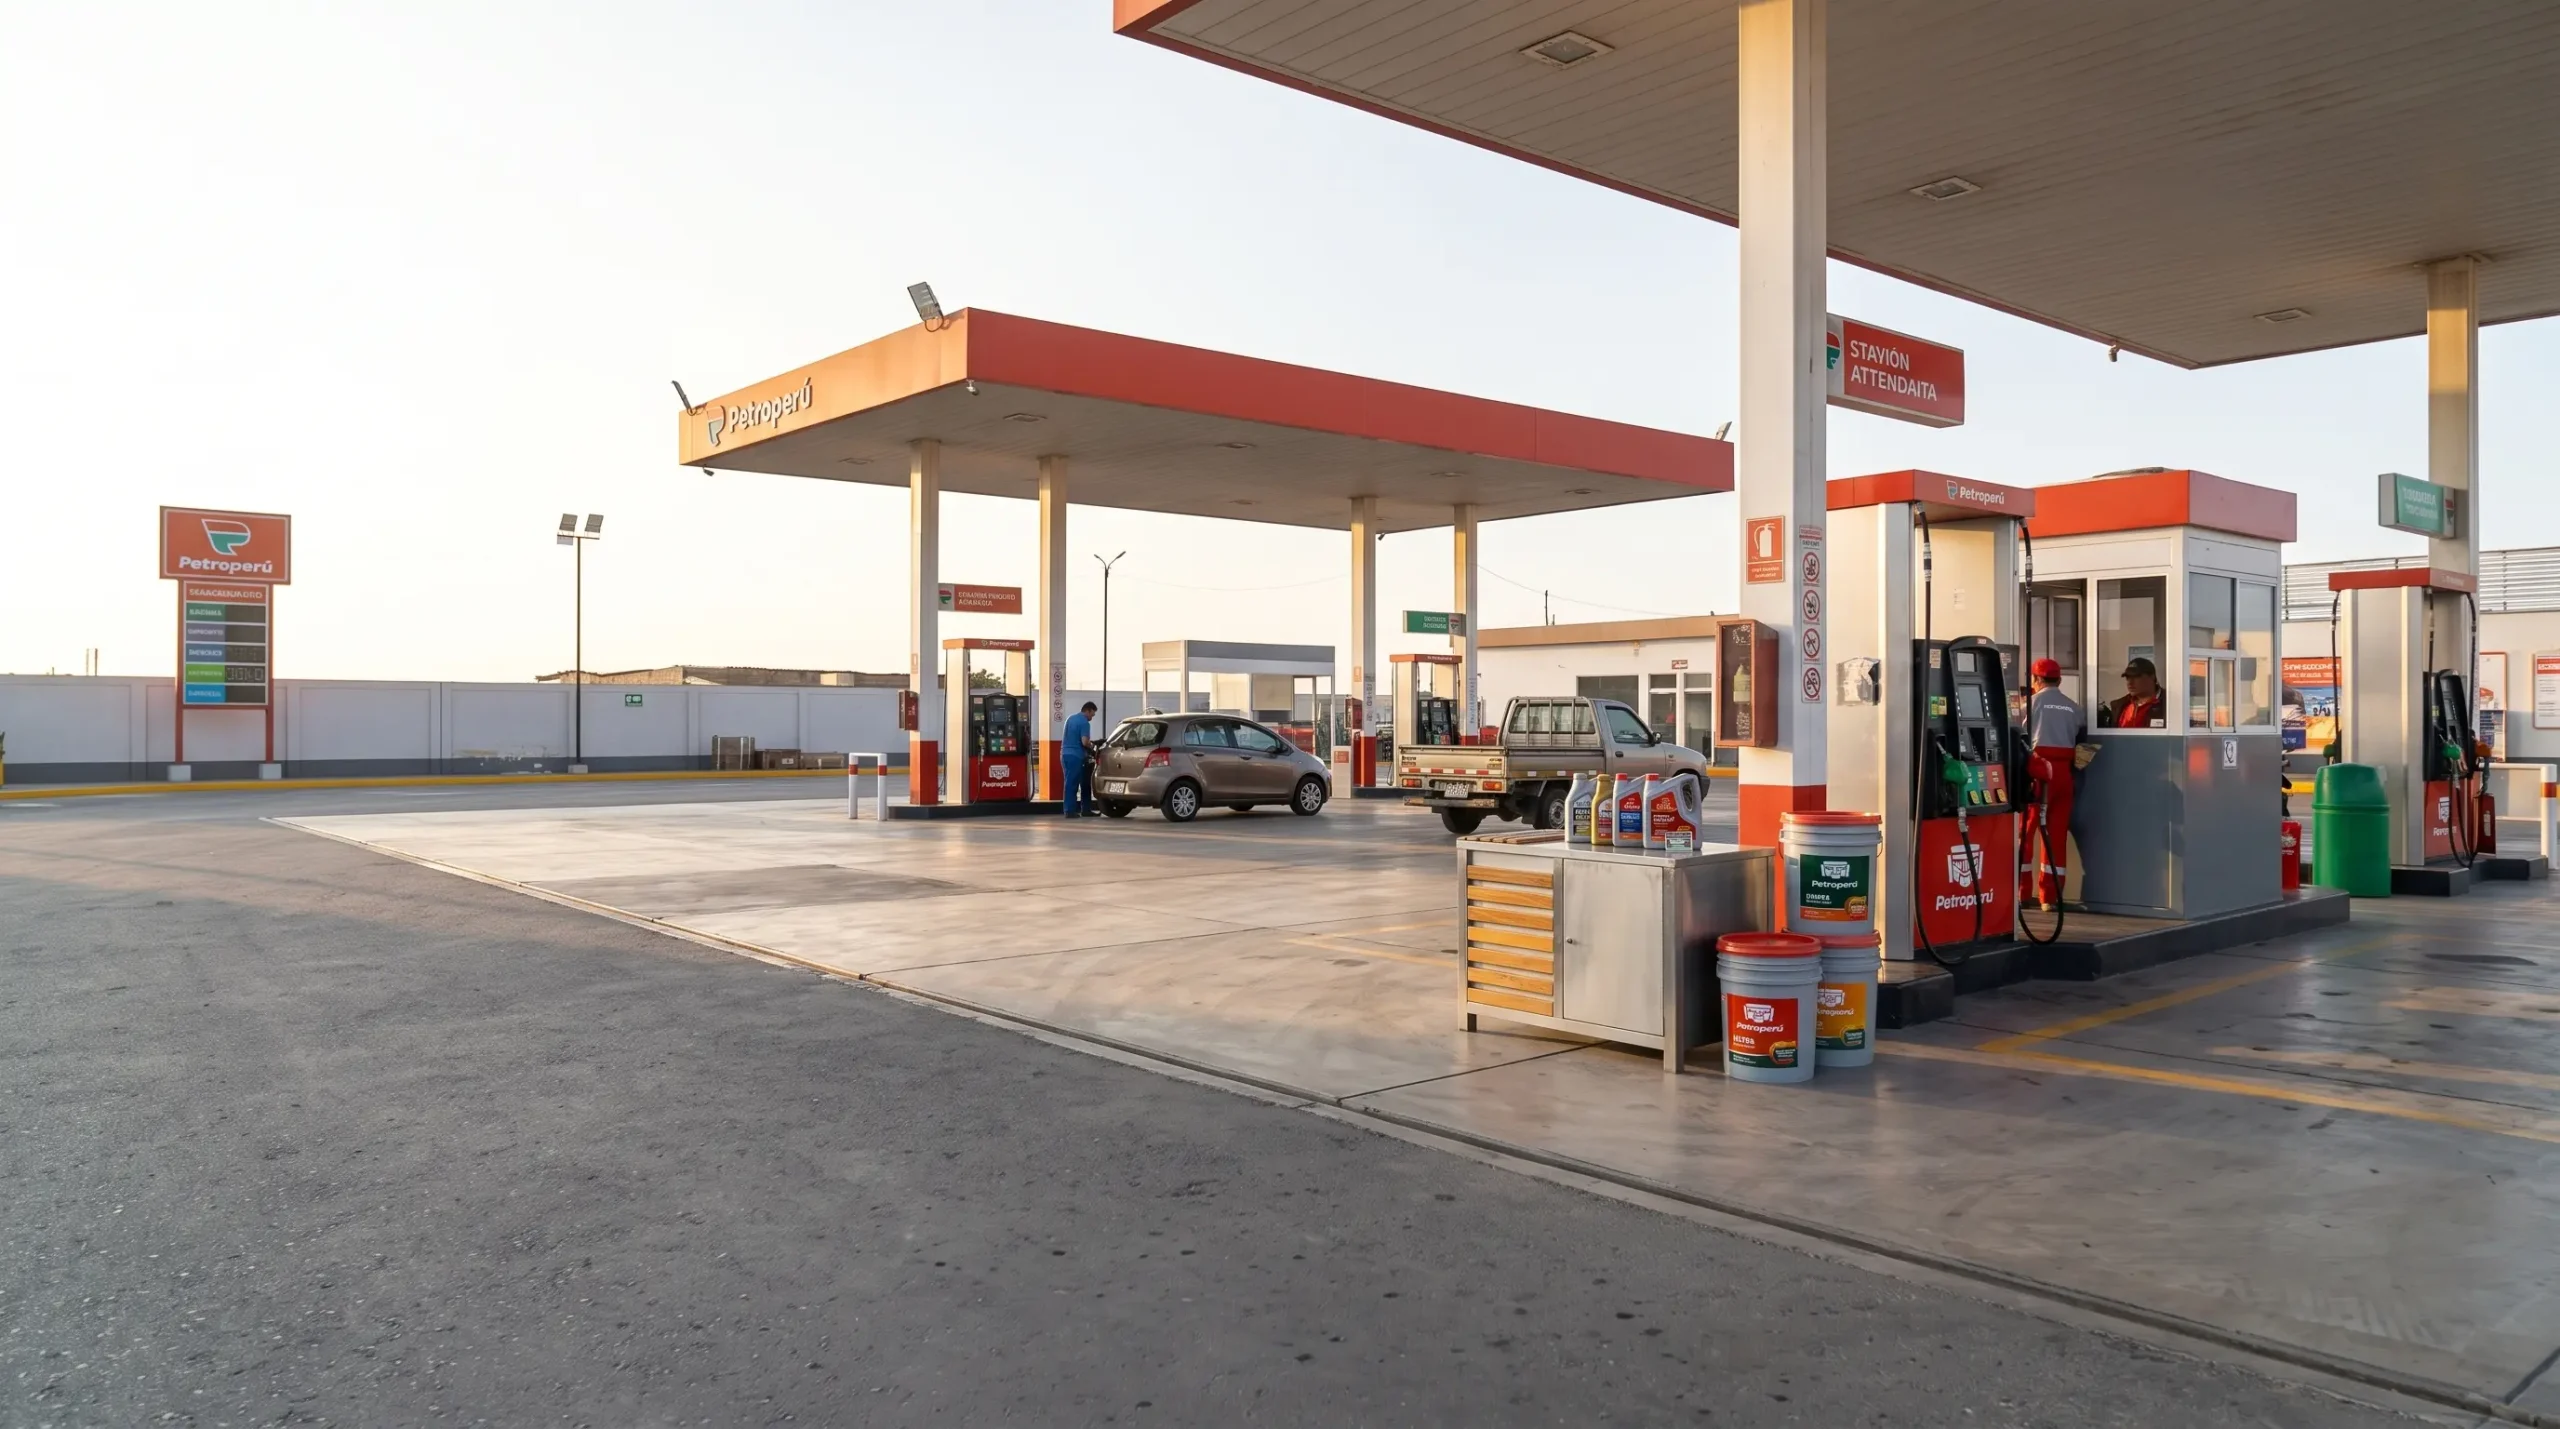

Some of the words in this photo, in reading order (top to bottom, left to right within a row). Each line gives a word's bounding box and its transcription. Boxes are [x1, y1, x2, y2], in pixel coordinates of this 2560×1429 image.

[1850, 340, 1909, 371] STAYIÓN
[1850, 365, 1937, 401] ATTENDAITA
[729, 377, 812, 433] Petroperú
[1960, 486, 2004, 506] Petroperú
[178, 556, 273, 574] Petroperú
